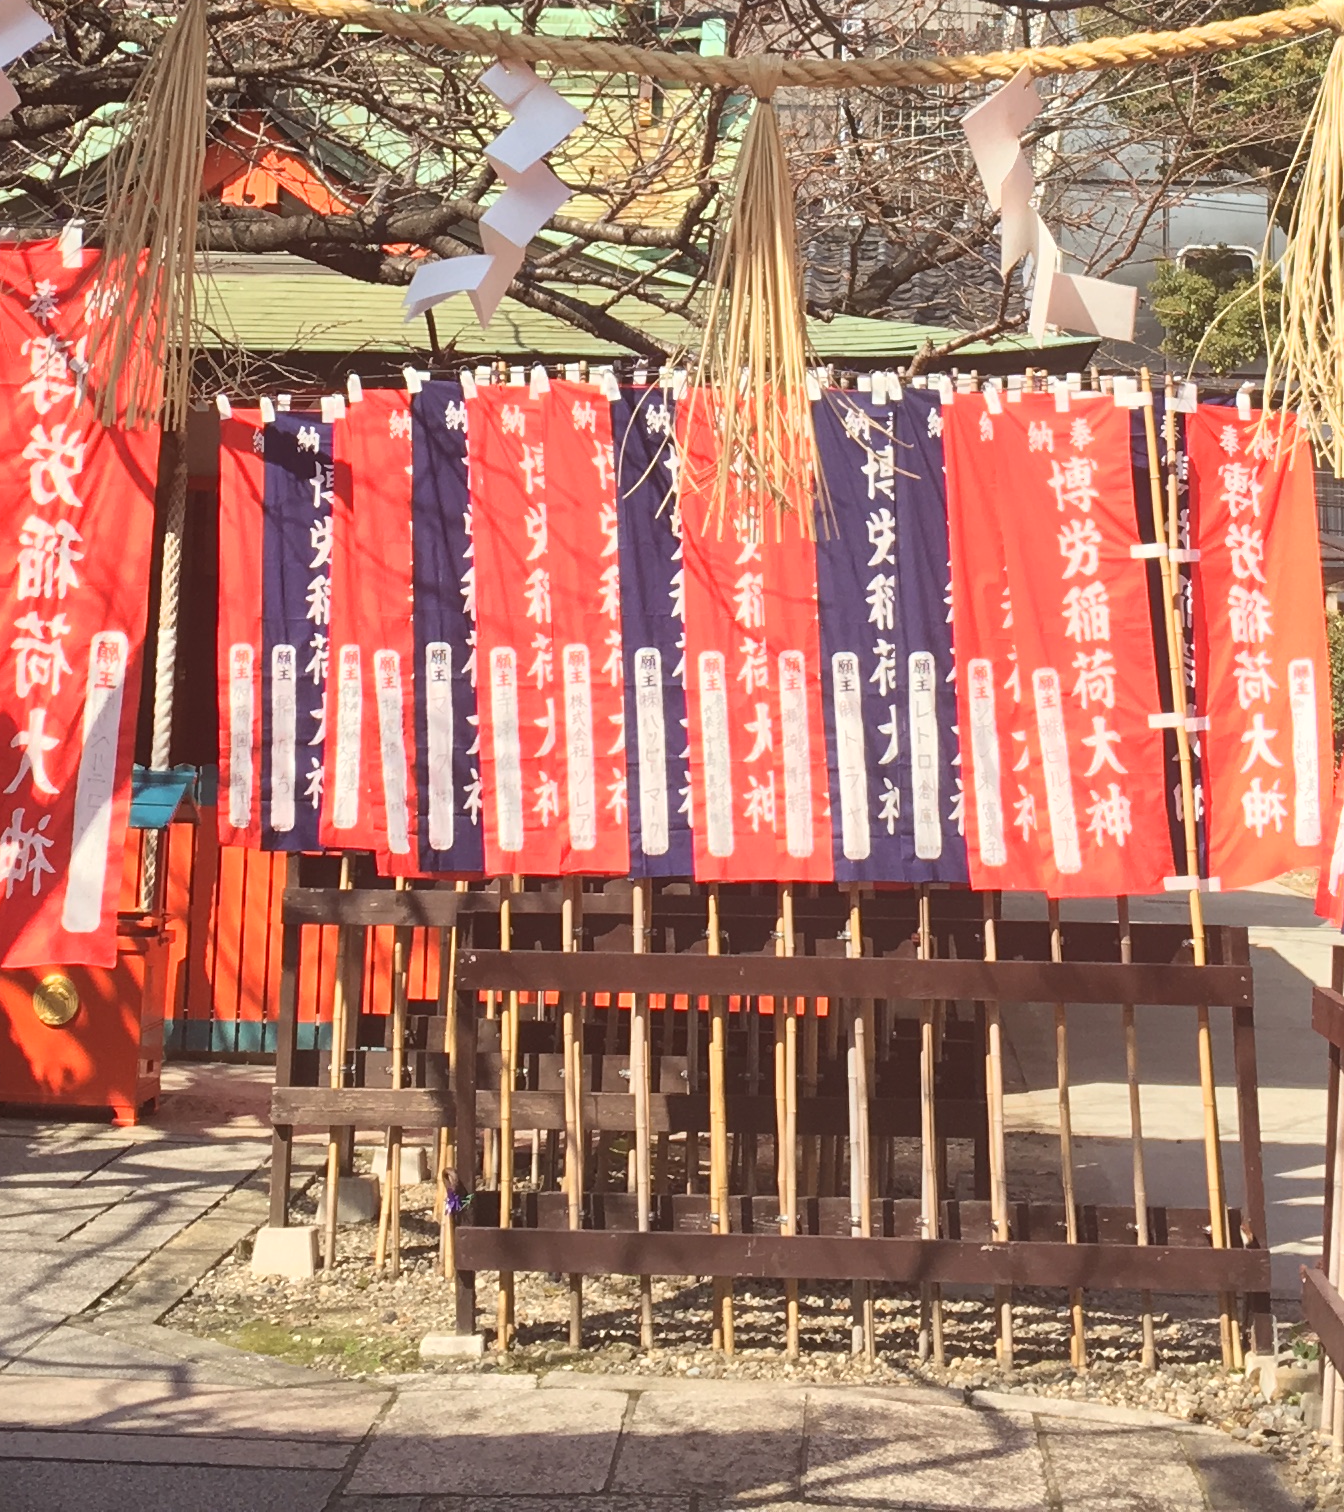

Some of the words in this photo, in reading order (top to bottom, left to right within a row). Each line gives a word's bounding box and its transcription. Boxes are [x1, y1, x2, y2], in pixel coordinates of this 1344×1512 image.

[501, 404, 526, 437] 納
[572, 400, 597, 434] 納
[297, 425, 321, 456] 納
[1028, 420, 1055, 453] 納
[1069, 417, 1096, 452] 奉
[277, 650, 292, 681] 願主
[430, 649, 449, 683] 願主
[568, 650, 587, 685] 願主
[1047, 456, 1132, 847] 博労稲荷大神
[495, 654, 513, 688] 願主
[639, 654, 657, 689] 願主
[837, 659, 856, 693] 願主
[913, 659, 932, 693] 願主
